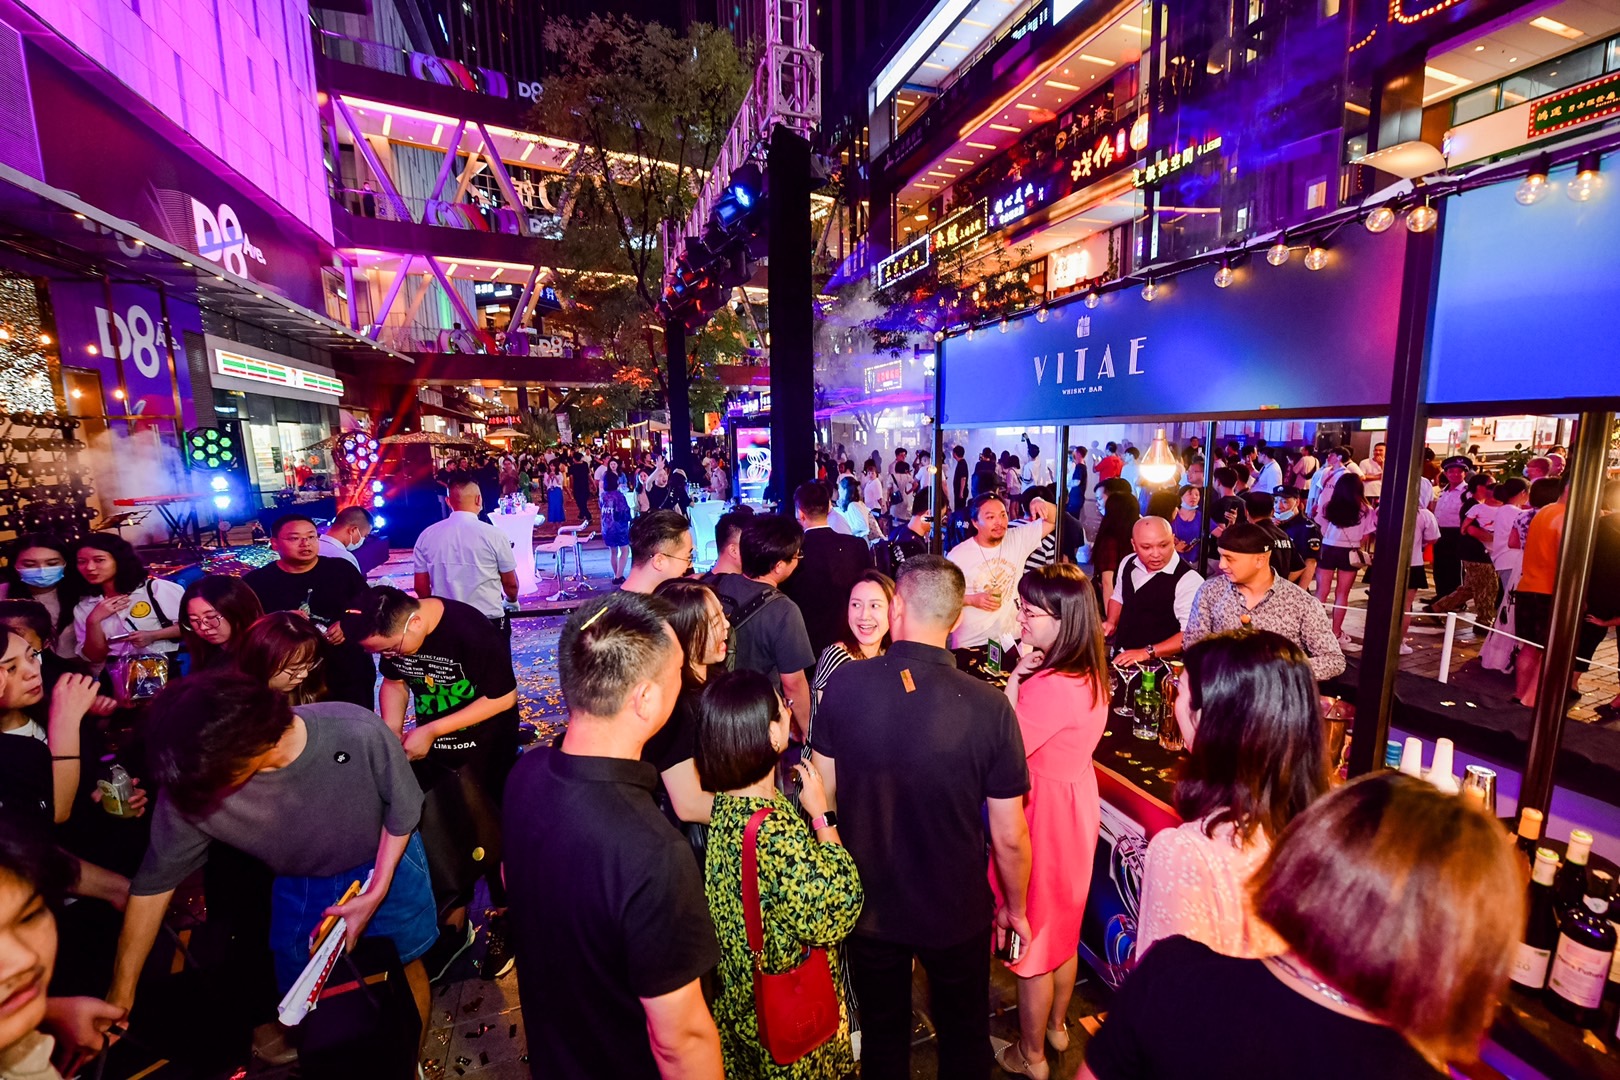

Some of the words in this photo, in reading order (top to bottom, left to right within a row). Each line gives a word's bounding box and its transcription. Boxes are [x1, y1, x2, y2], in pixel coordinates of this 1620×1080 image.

[191, 197, 248, 279] D8
[243, 233, 267, 265] Ave.
[95, 305, 160, 379] D8
[155, 325, 181, 351] Ae.
[1033, 336, 1148, 387] VITAE
[1061, 386, 1087, 396] WHISKY
[1088, 385, 1103, 394] BAR
[433, 742, 452, 750] LIME
[452, 740, 477, 750] SODA
